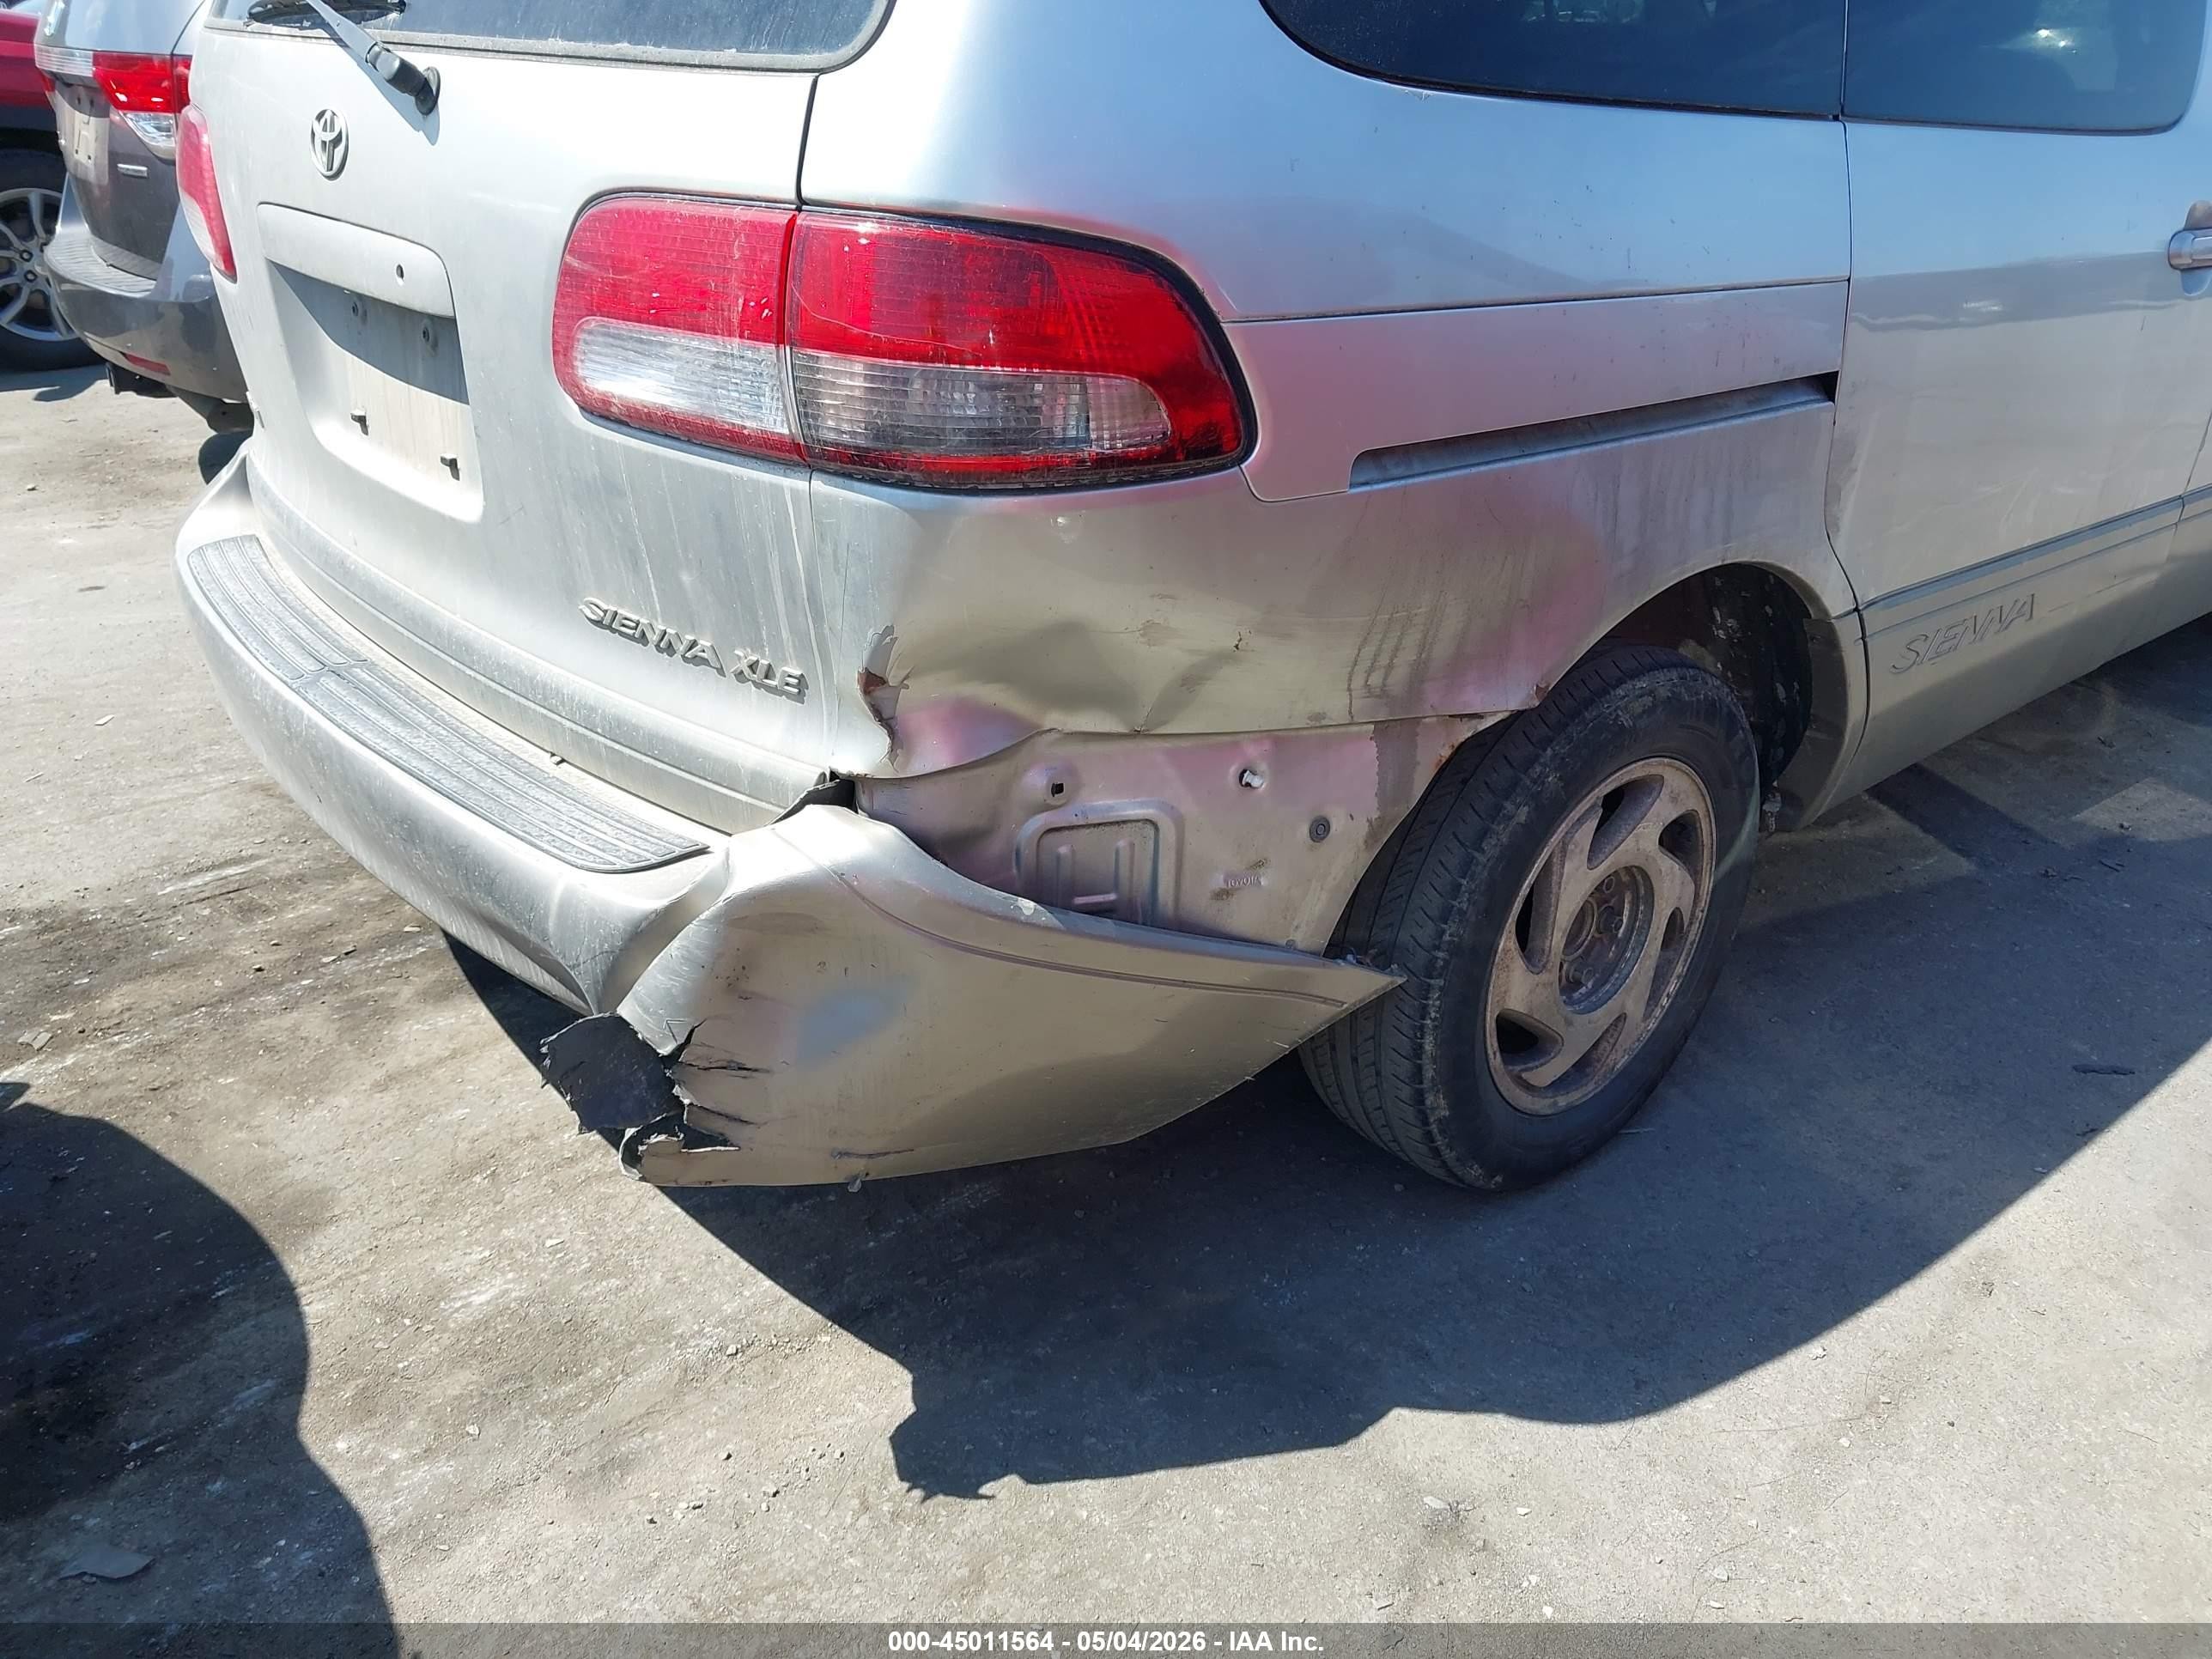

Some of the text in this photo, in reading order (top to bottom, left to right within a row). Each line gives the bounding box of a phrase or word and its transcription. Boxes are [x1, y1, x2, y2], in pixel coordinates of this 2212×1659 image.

[578, 597, 809, 703] SIENNA XLE
[1889, 592, 2035, 675] SIENNA
